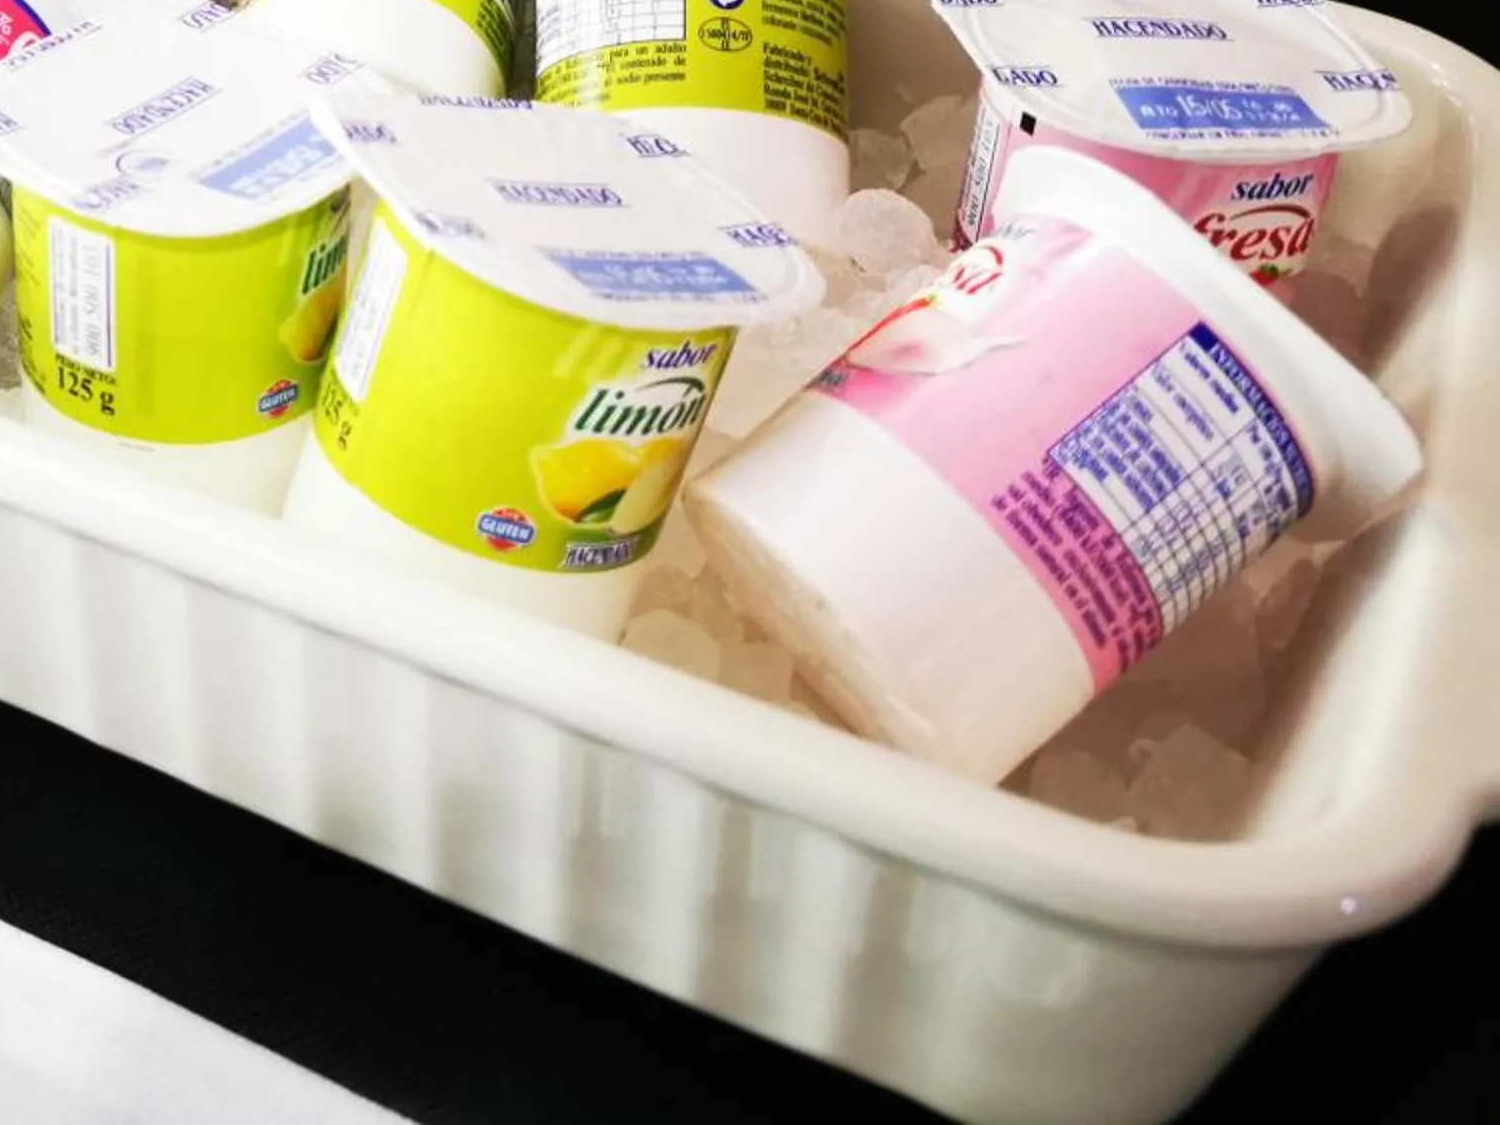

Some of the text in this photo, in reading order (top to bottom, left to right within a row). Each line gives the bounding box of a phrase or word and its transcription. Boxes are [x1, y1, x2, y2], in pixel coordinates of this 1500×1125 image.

[1093, 20, 1228, 40] HACENDADO
[1230, 171, 1315, 201] sabor
[1193, 212, 1316, 262] fresa
[643, 339, 717, 370] sabor
[57, 366, 116, 417] 125 g
[480, 516, 531, 542] GLUTEN
